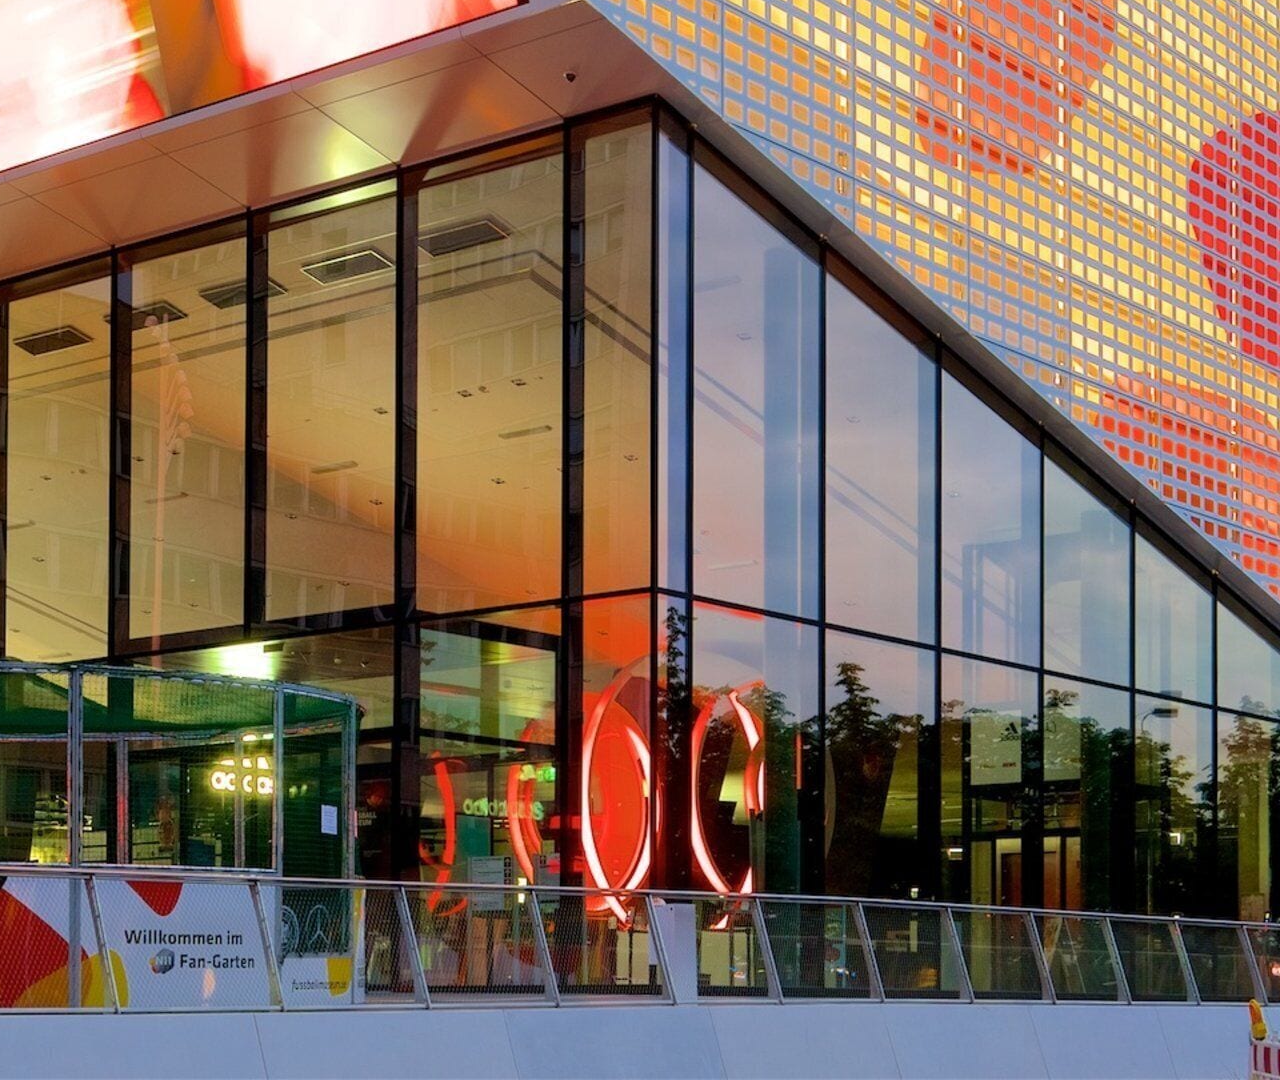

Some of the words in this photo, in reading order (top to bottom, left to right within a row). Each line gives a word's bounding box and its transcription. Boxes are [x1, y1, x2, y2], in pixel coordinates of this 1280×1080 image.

[124, 929, 223, 946] Willkommen
[226, 930, 243, 946] im
[179, 953, 256, 970] Fan-Garten
